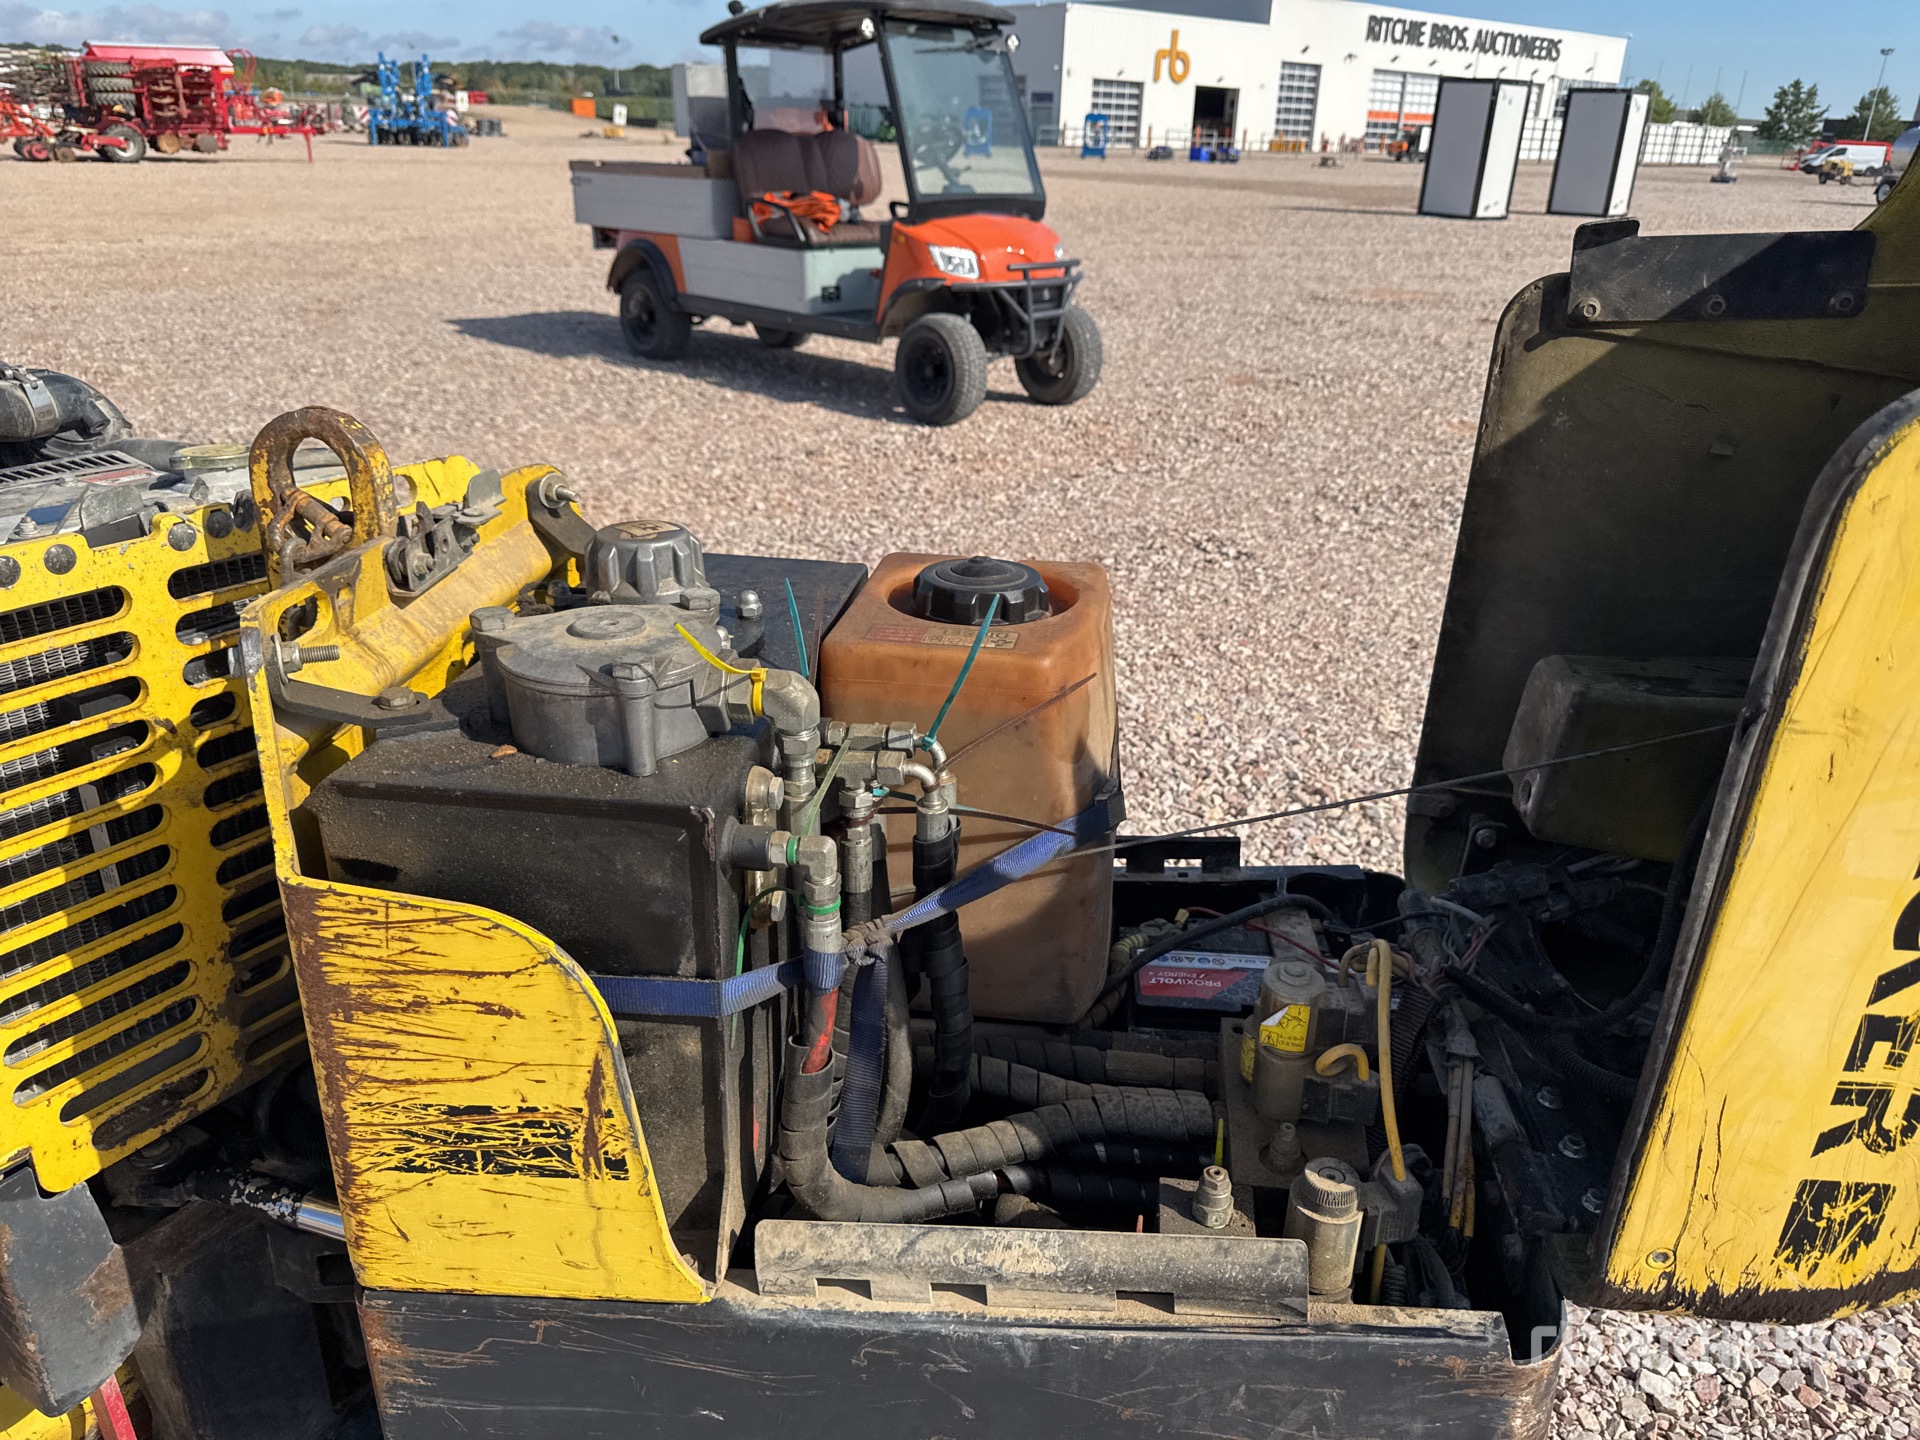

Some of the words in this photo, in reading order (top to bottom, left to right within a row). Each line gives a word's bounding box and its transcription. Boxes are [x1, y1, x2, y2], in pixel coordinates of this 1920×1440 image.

[1153, 29, 1190, 84] rb
[1366, 15, 1427, 46] RITCHIE
[1428, 23, 1469, 51] BROS.
[1472, 28, 1562, 62] AUCTIONEERS
[1148, 977, 1221, 987] PROXIVOLT
